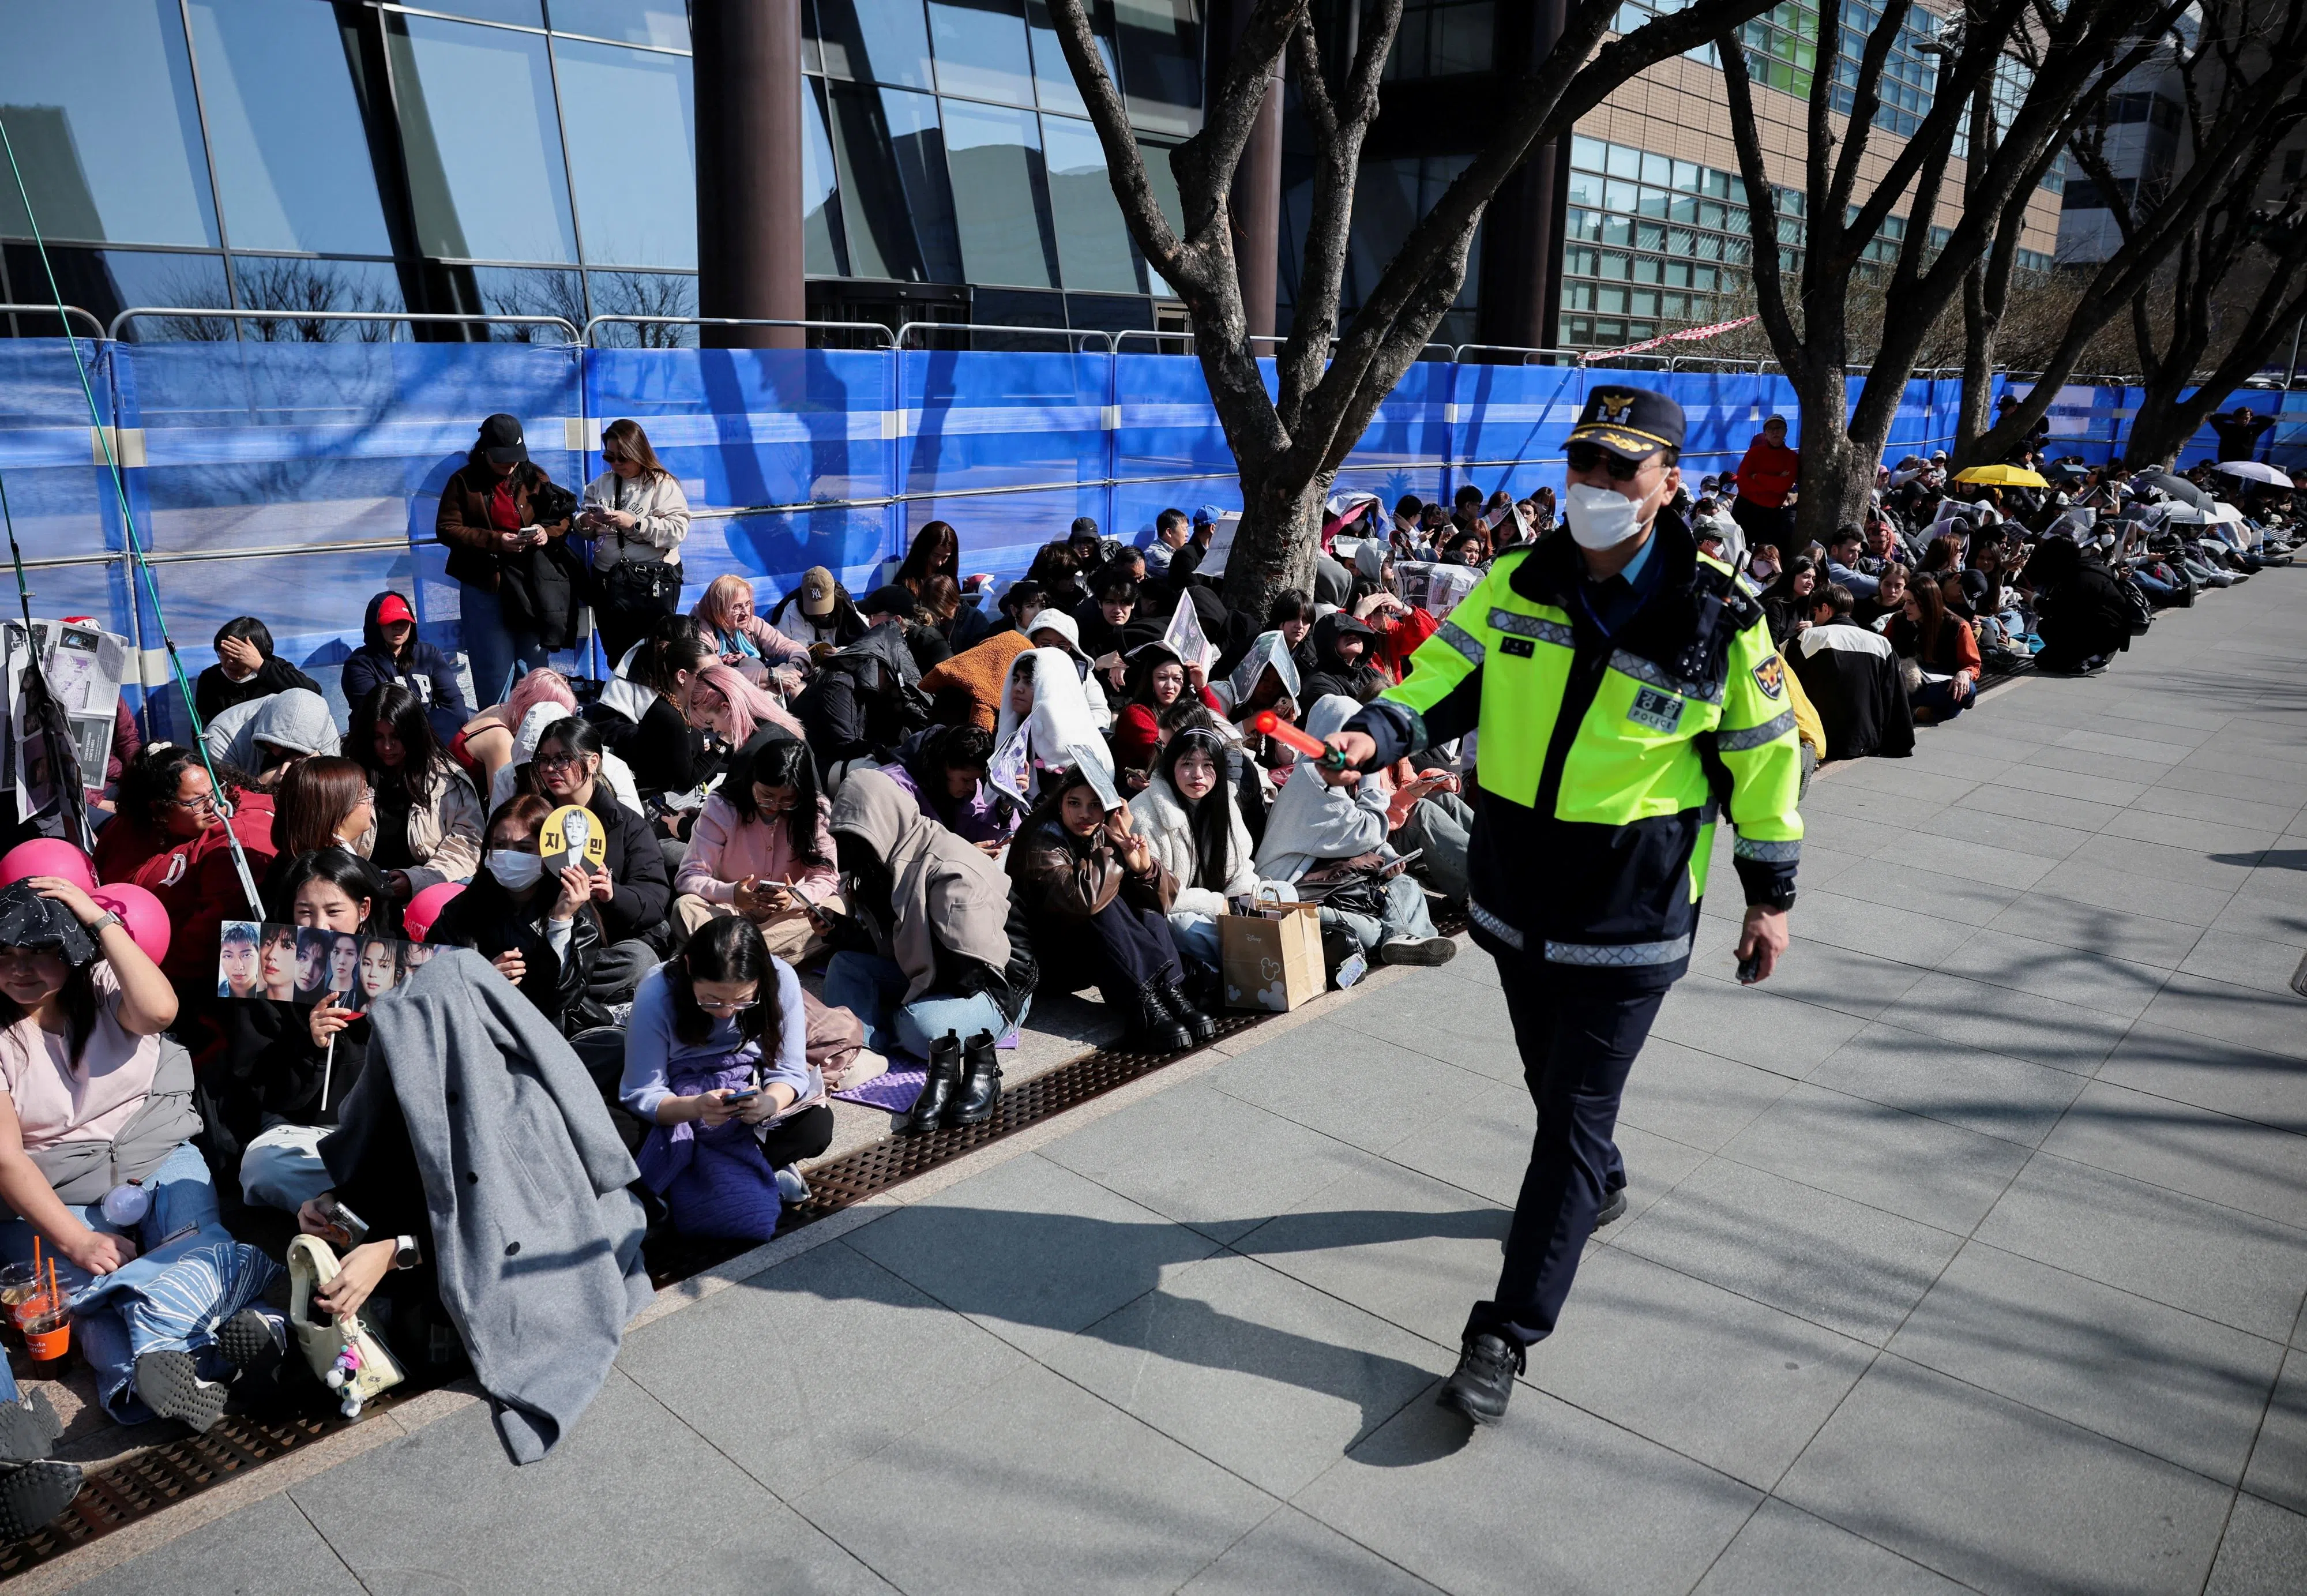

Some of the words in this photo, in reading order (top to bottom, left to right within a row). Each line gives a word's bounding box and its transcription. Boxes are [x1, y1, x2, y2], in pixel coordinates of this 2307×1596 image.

[629, 502, 644, 515] GOD
[811, 588, 822, 599] NY
[1633, 710, 1673, 730] POLICE
